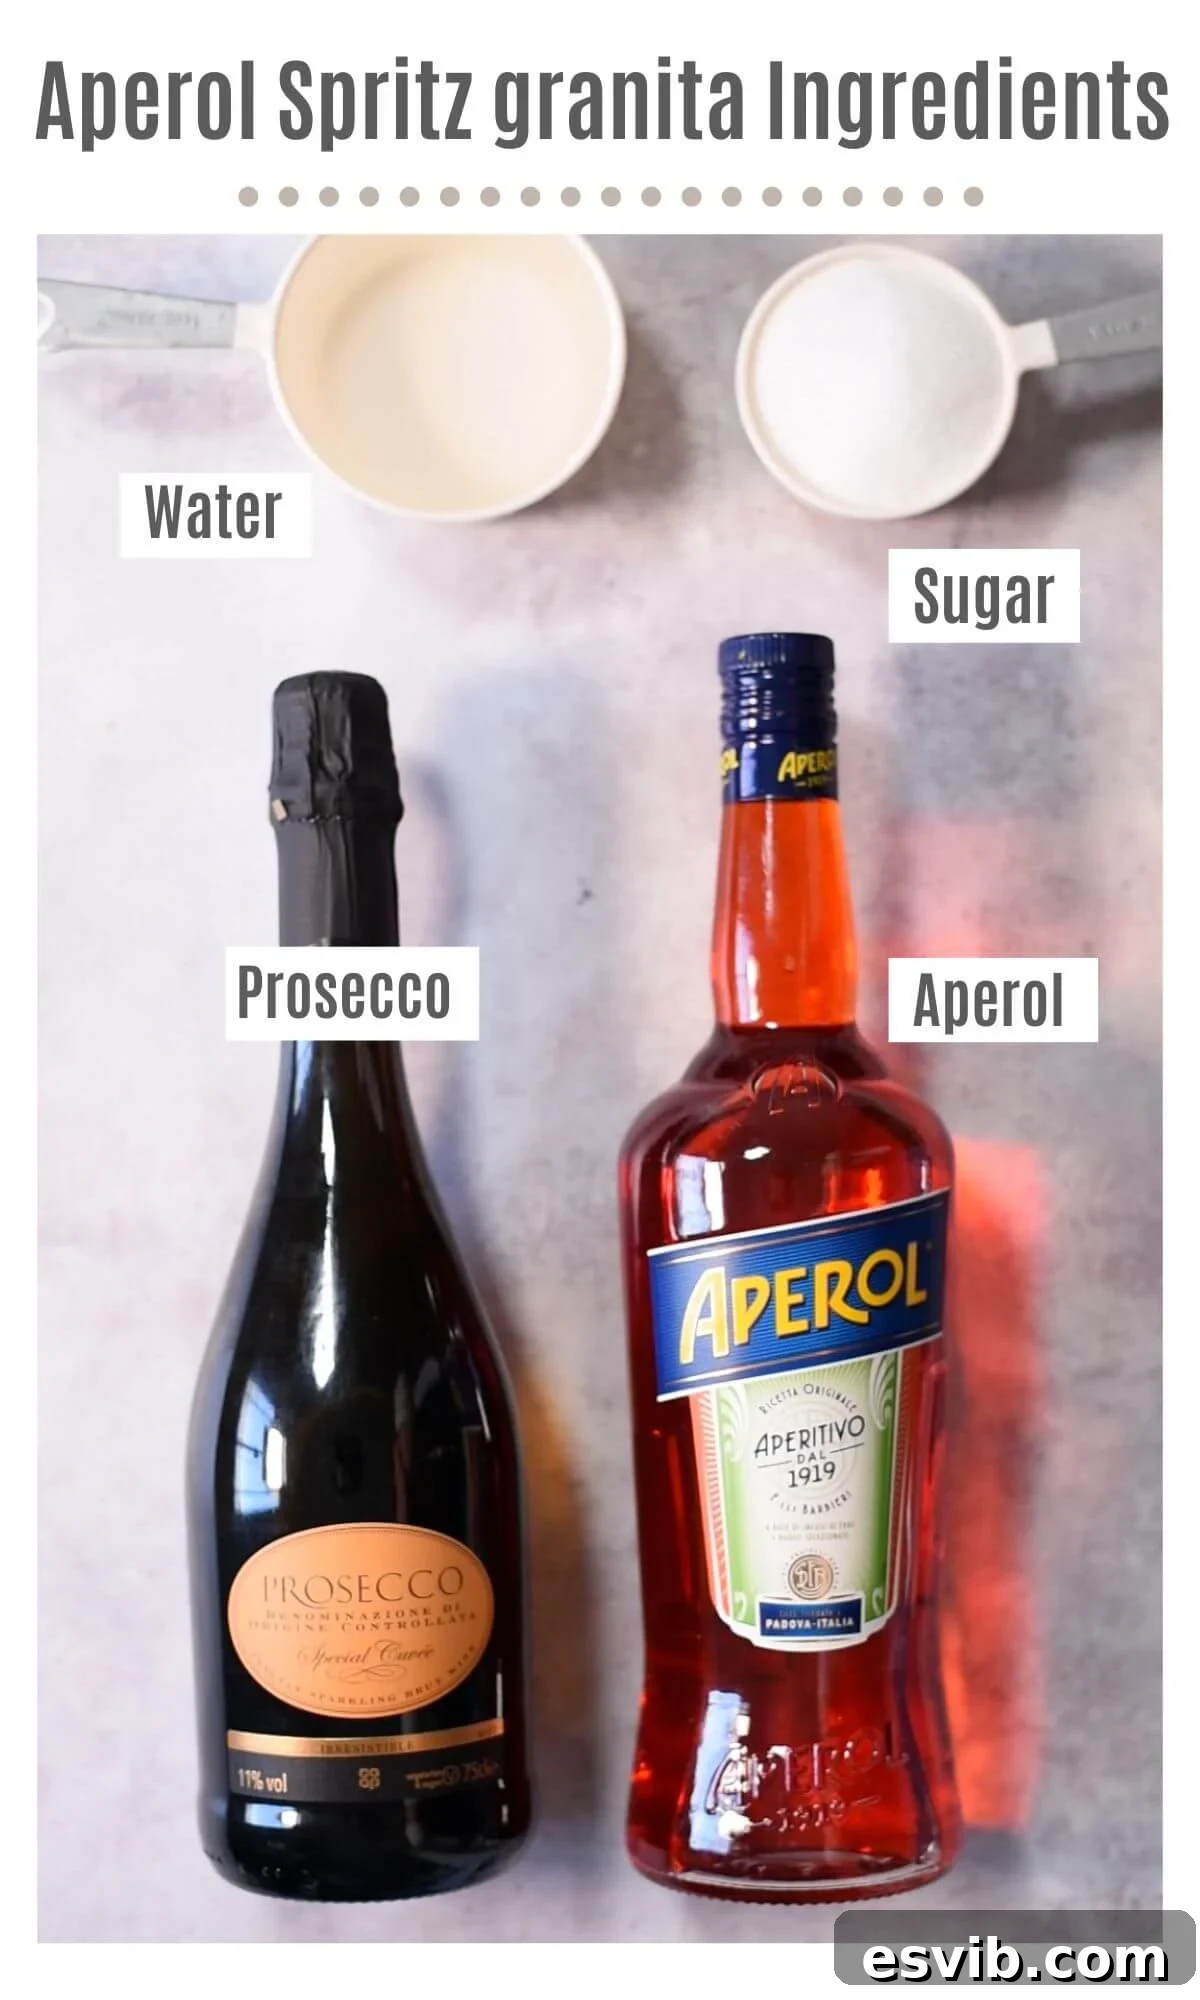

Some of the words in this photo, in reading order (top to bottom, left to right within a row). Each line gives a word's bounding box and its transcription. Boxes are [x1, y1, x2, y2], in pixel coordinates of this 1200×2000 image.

[679, 1240, 927, 1365] APEROL
[758, 1388, 799, 1415] RICETTA
[803, 1383, 857, 1412] ORIGINALE
[754, 1414, 866, 1459] APERITIVO
[797, 1450, 827, 1465] DAL
[787, 1461, 837, 1488] 1919
[263, 1566, 465, 1610] PROSECCO
[249, 1619, 328, 1633] ORIGINE
[341, 1610, 478, 1633] CONTROLLATA
[266, 1607, 433, 1622] DENOMINAZIONE
[442, 1601, 461, 1614] DI
[297, 1645, 373, 1673] Special
[237, 1768, 264, 1791] 11%
[266, 1772, 288, 1794] vol
